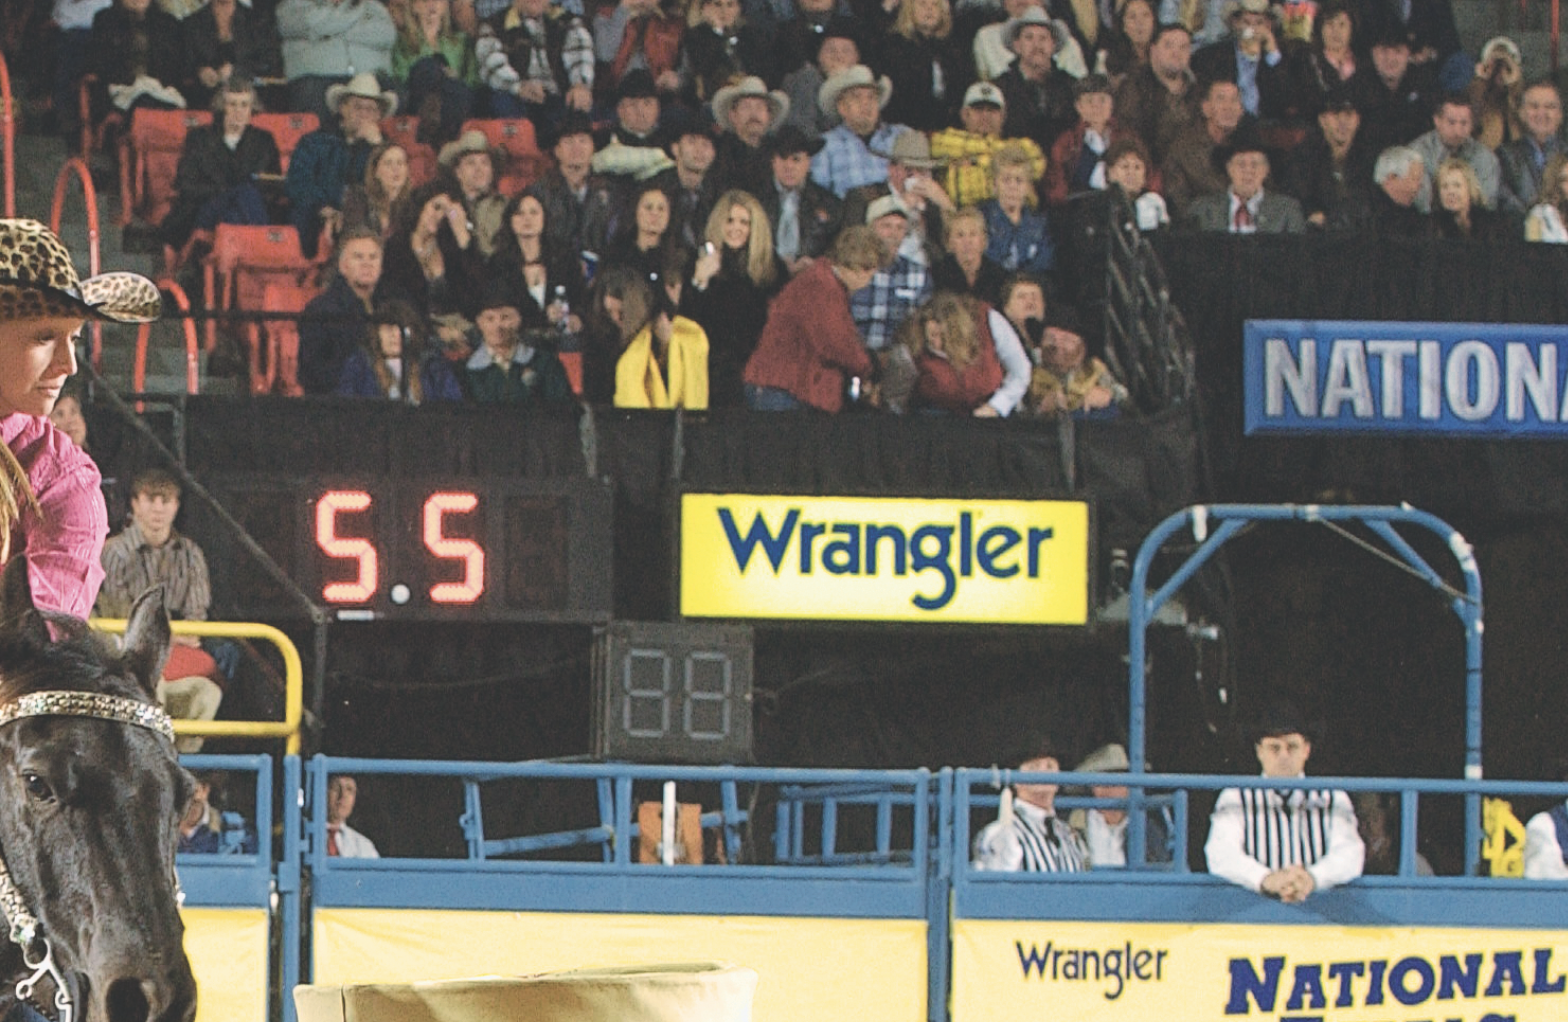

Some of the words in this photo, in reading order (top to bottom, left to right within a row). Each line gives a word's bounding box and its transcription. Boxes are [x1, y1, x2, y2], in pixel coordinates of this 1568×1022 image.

[1264, 339, 1568, 421] NATION
[717, 507, 1054, 610] Wrangler
[1015, 941, 1168, 1000] Wrangler
[1224, 948, 1567, 1015] NATIONAL
